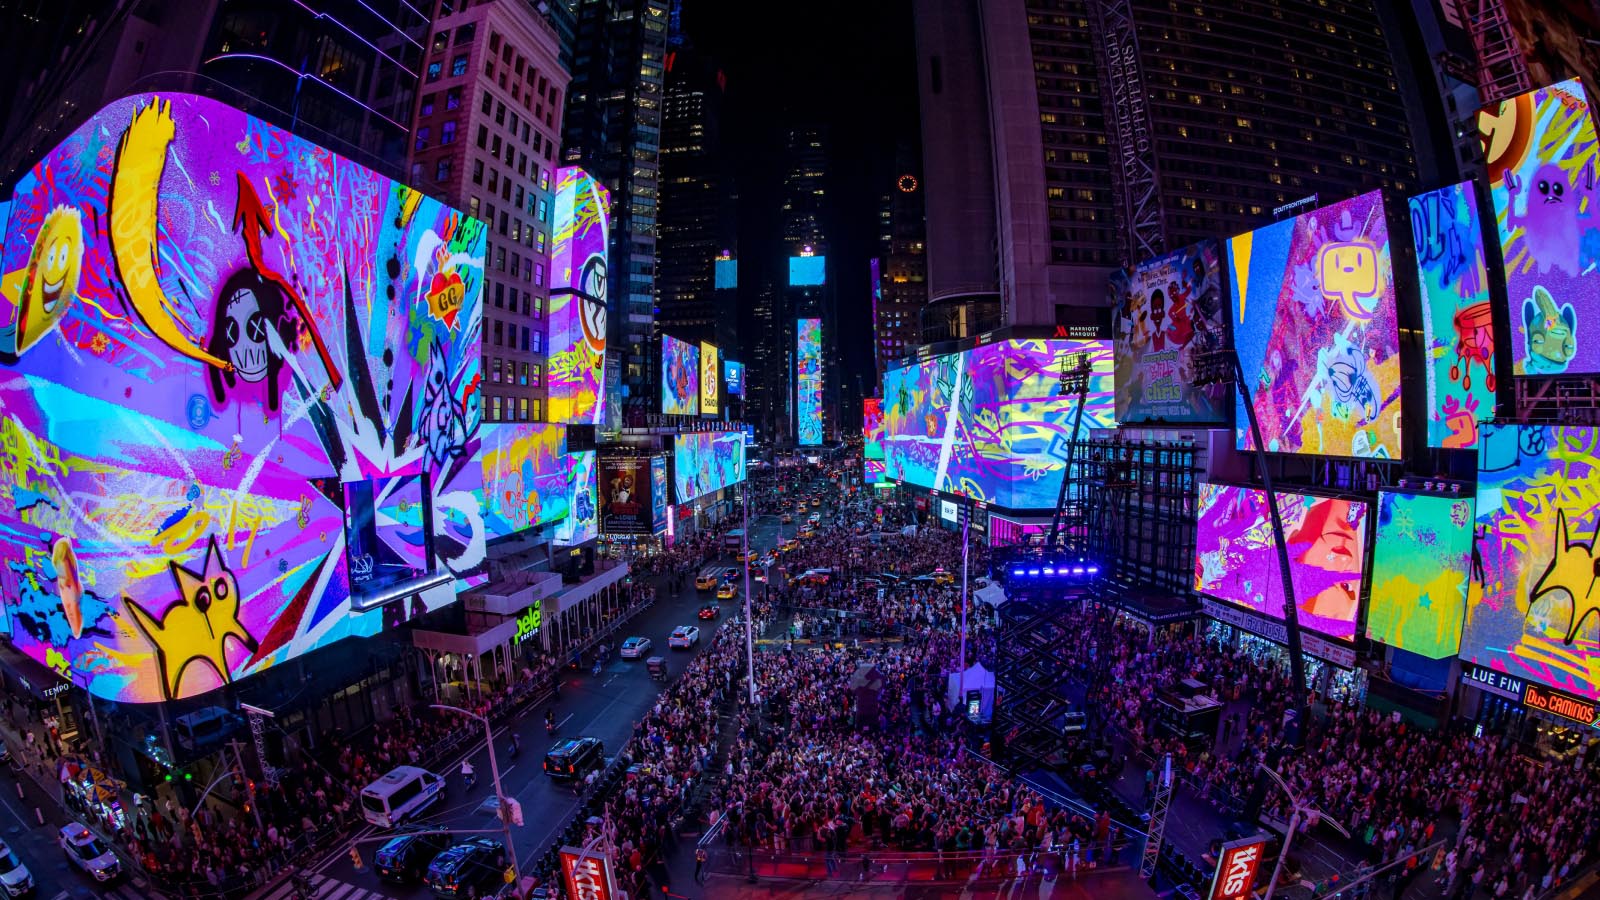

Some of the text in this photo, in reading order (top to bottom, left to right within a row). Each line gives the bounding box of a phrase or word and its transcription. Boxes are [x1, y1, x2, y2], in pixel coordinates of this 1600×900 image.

[1105, 31, 1138, 185] AMERICAN EAGLE
[1121, 45, 1151, 153] OUTFITTERS
[438, 287, 456, 312] GG
[1145, 382, 1180, 401] chris
[43, 682, 70, 699] TEMPO
[1498, 677, 1521, 693] FIN
[1548, 696, 1595, 723] CAMINOS
[1224, 847, 1257, 896] tkts
